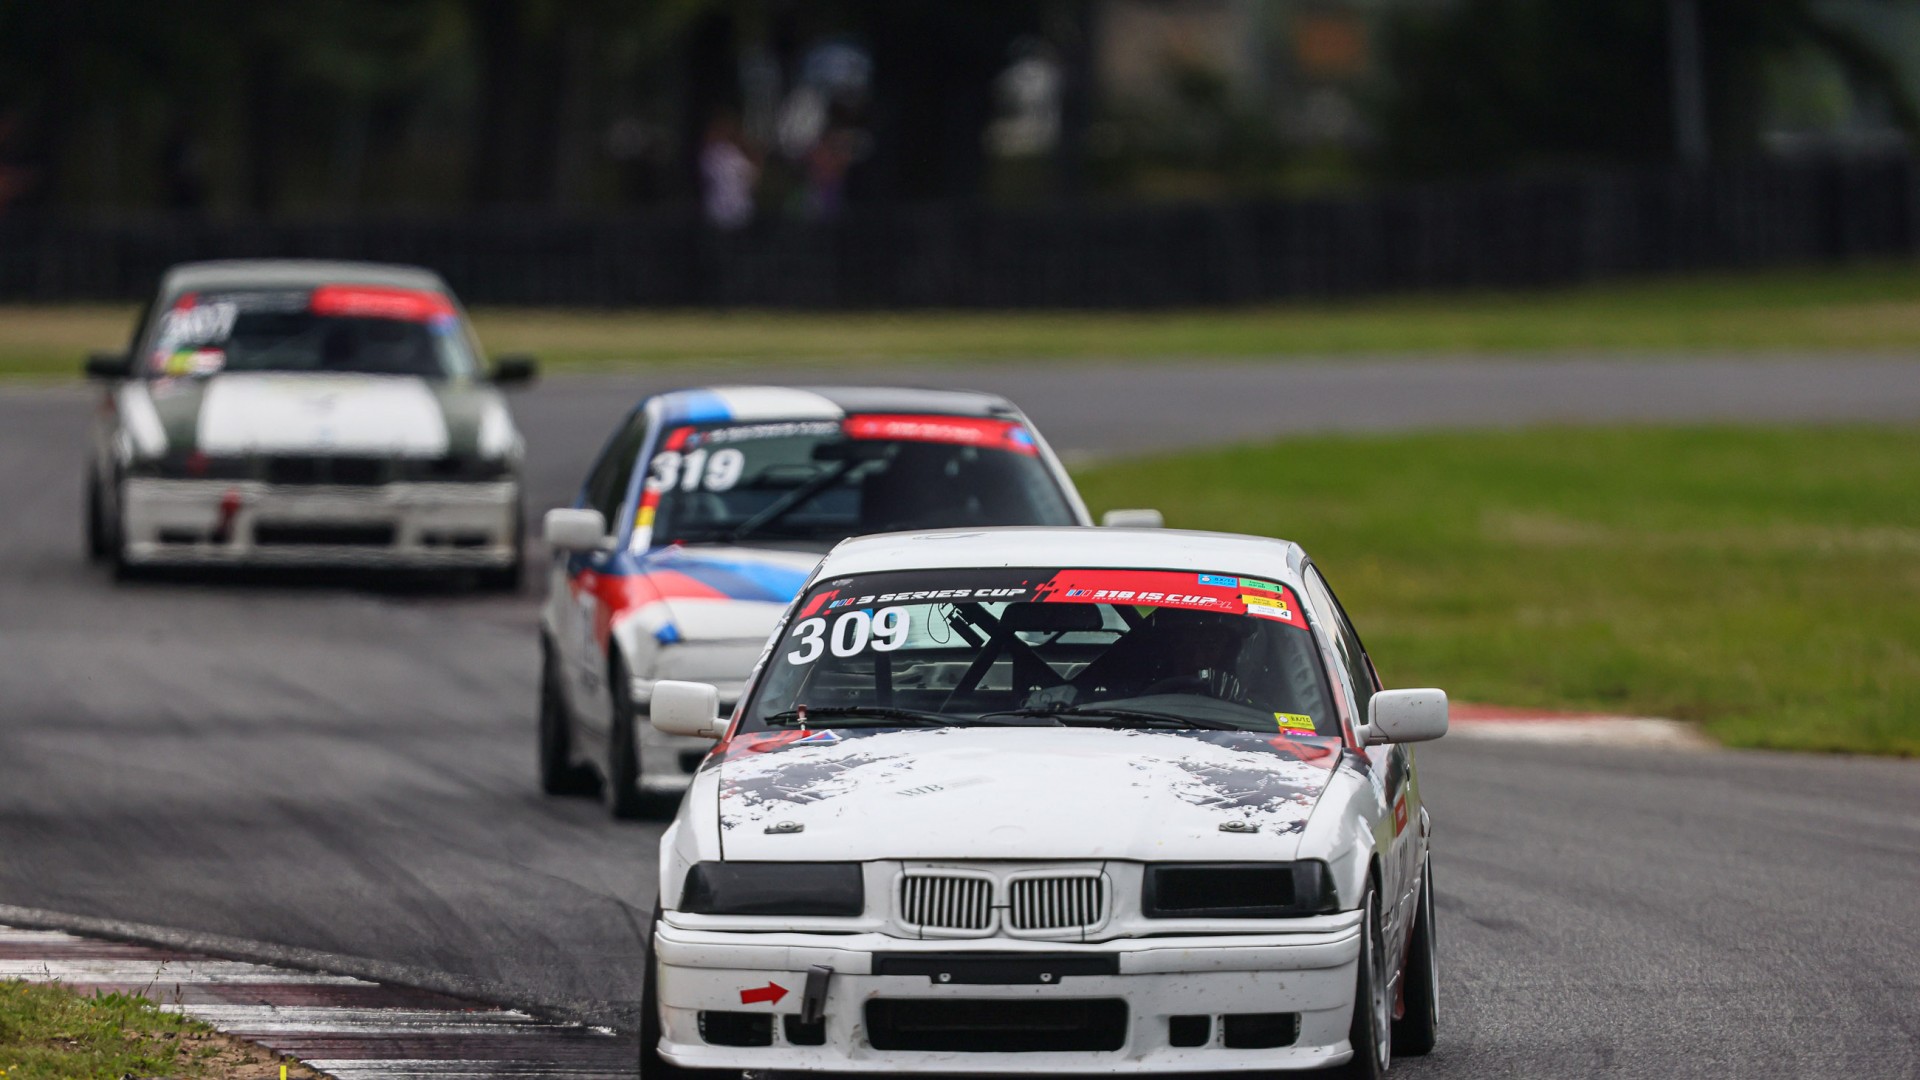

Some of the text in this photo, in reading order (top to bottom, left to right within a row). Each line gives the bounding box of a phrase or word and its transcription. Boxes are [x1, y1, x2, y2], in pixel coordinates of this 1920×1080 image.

[645, 447, 745, 493] 319
[856, 588, 1026, 605] 3 SERIES CUP
[1094, 589, 1136, 599] 318
[1138, 591, 1165, 601] IS
[1165, 593, 1218, 605] CUP
[787, 605, 911, 666] 309
